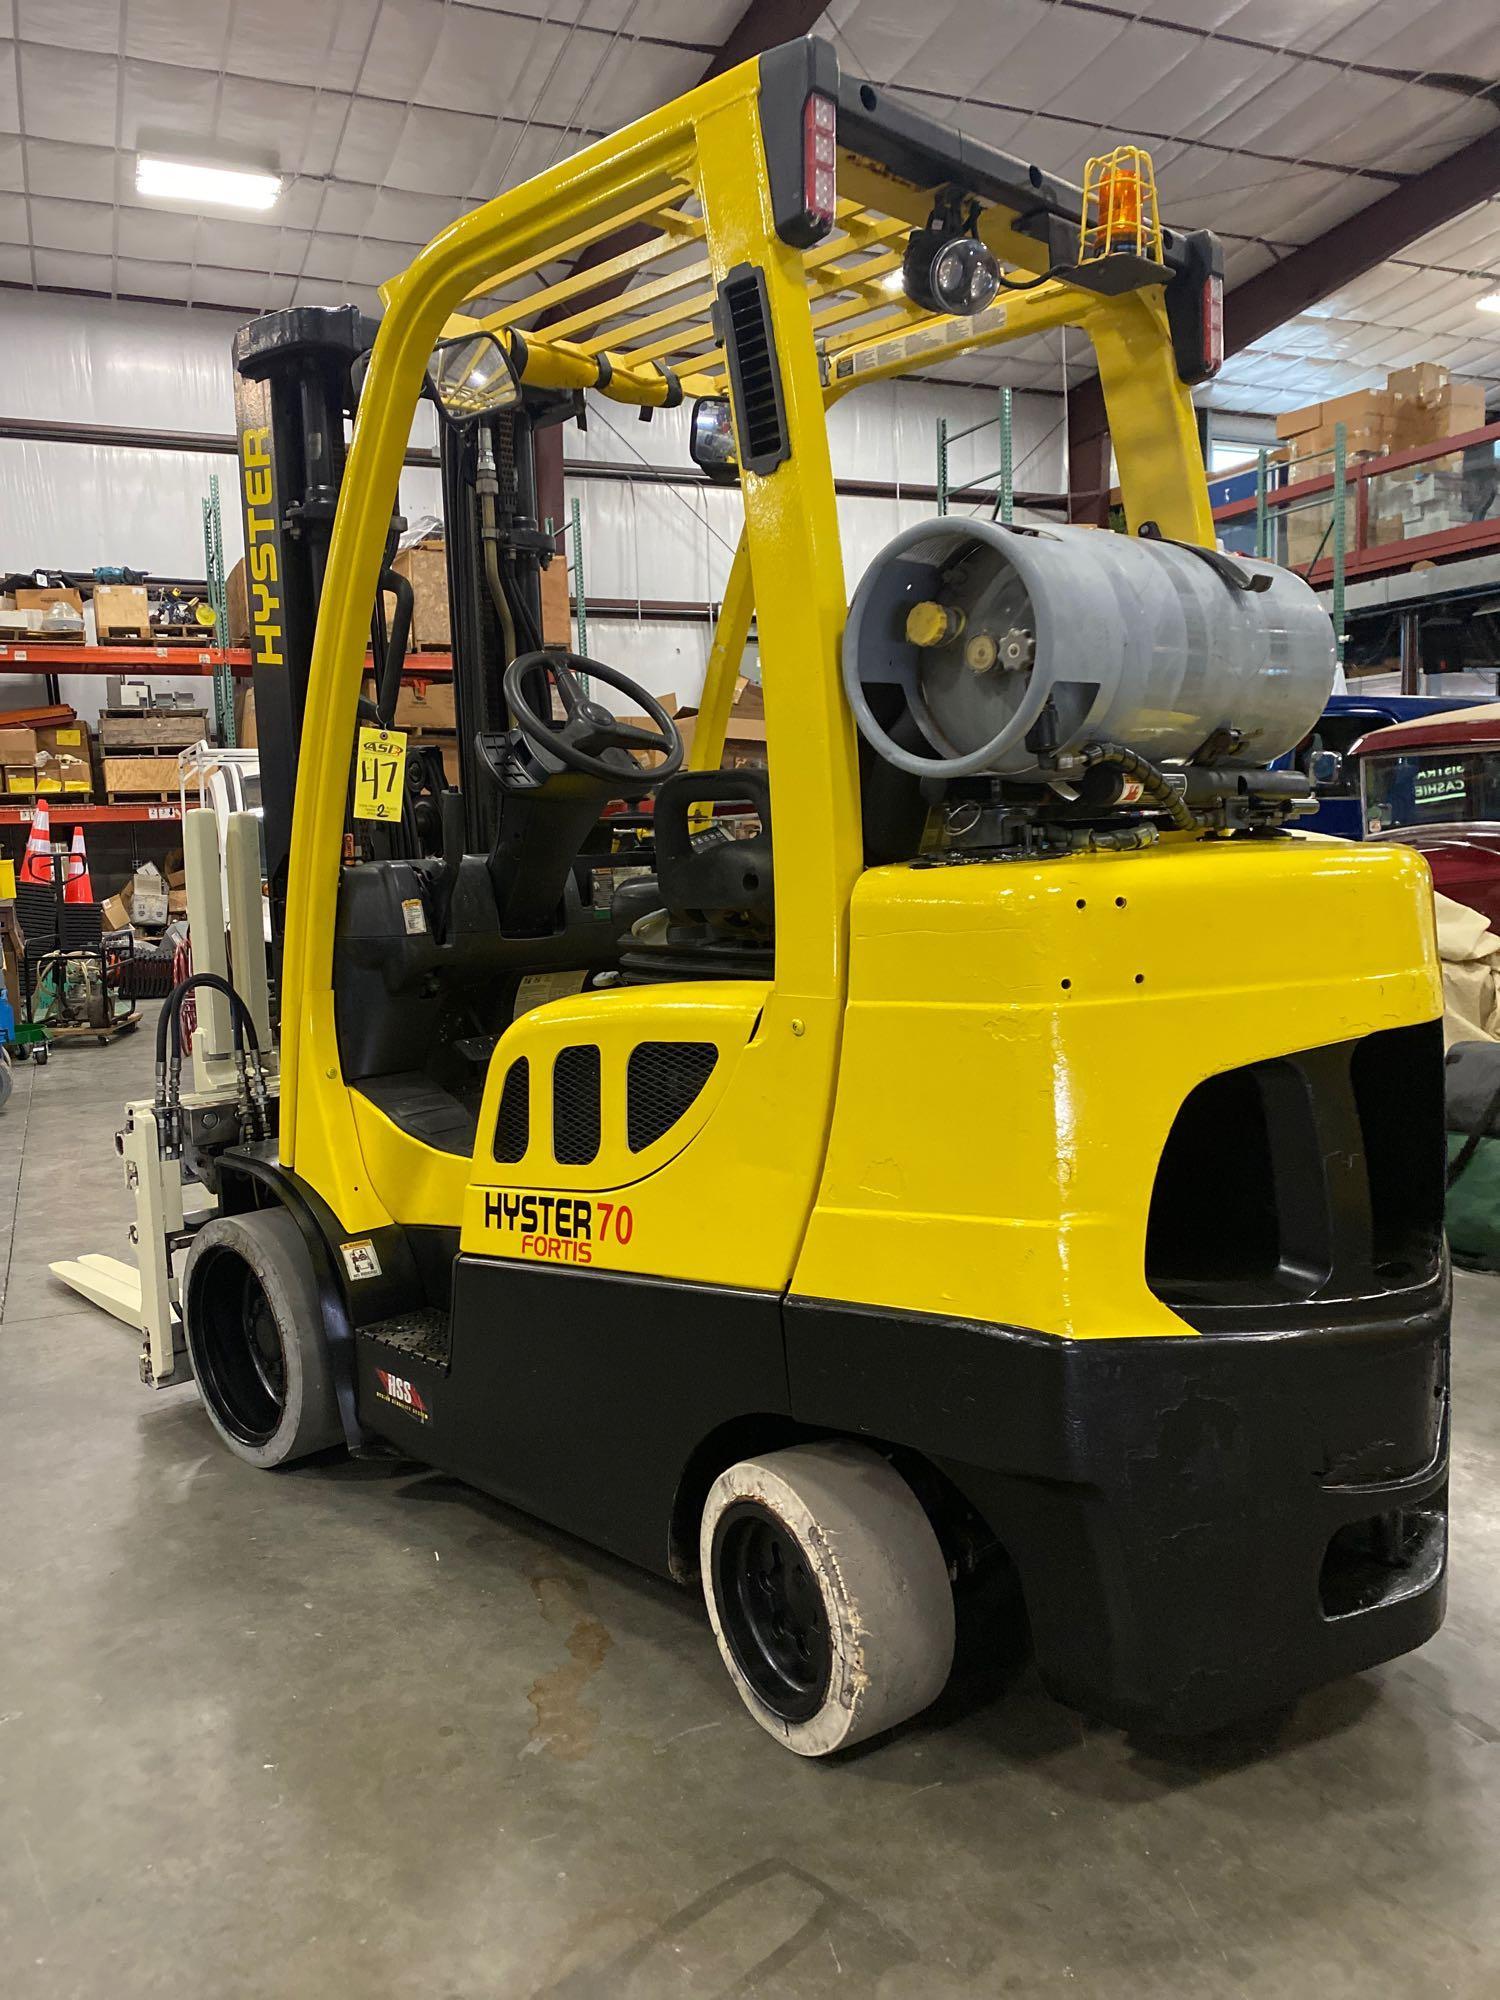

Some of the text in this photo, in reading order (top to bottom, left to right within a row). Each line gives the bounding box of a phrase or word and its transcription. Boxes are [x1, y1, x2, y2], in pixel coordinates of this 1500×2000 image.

[242, 426, 284, 666] HYSTER
[361, 757, 398, 801] 47
[484, 1191, 633, 1245] HYSTER 70
[521, 1234, 592, 1264] FORTIS
[387, 1372, 412, 1404] HSS
